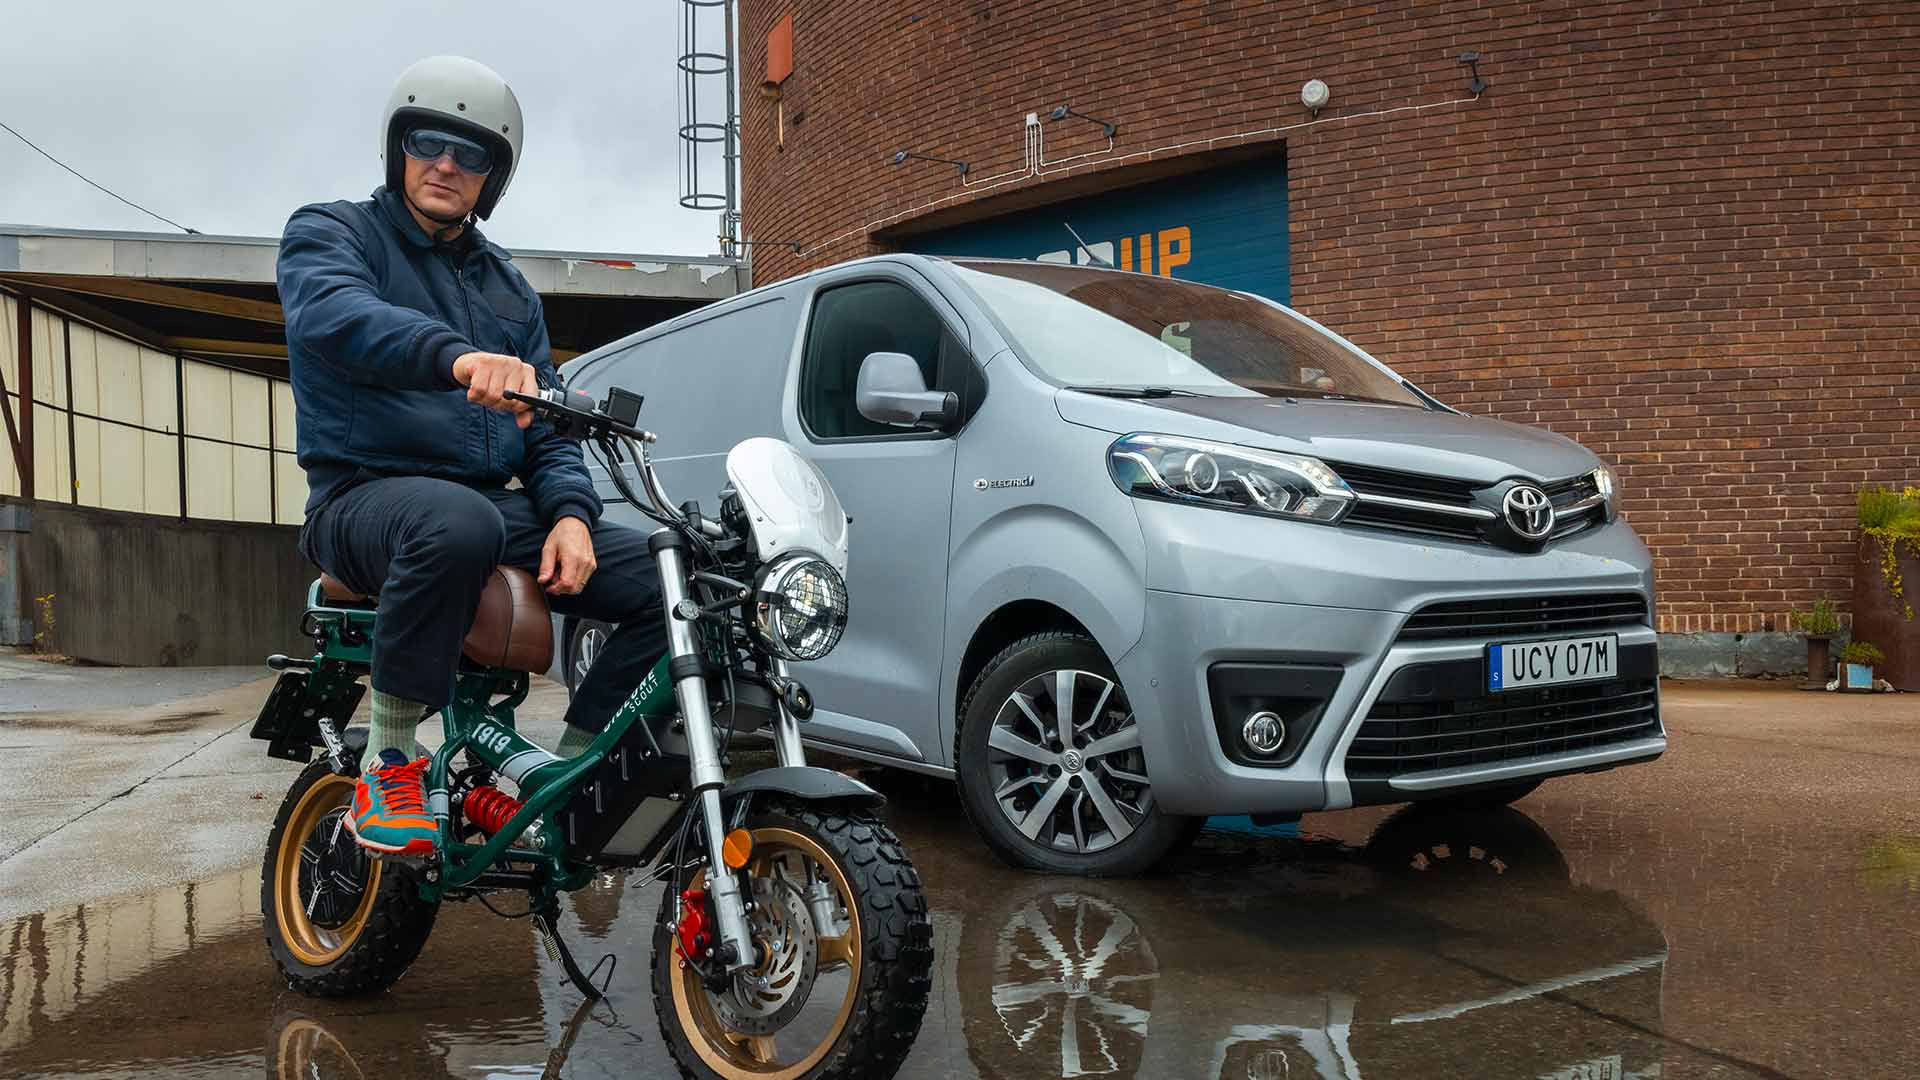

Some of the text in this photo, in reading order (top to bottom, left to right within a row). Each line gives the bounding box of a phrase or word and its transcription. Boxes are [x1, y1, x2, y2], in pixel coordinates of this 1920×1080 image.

[1493, 672, 1499, 681] S
[1512, 640, 1608, 681] UCY 07M
[629, 678, 658, 712] SCOUT
[472, 722, 512, 754] 1919
